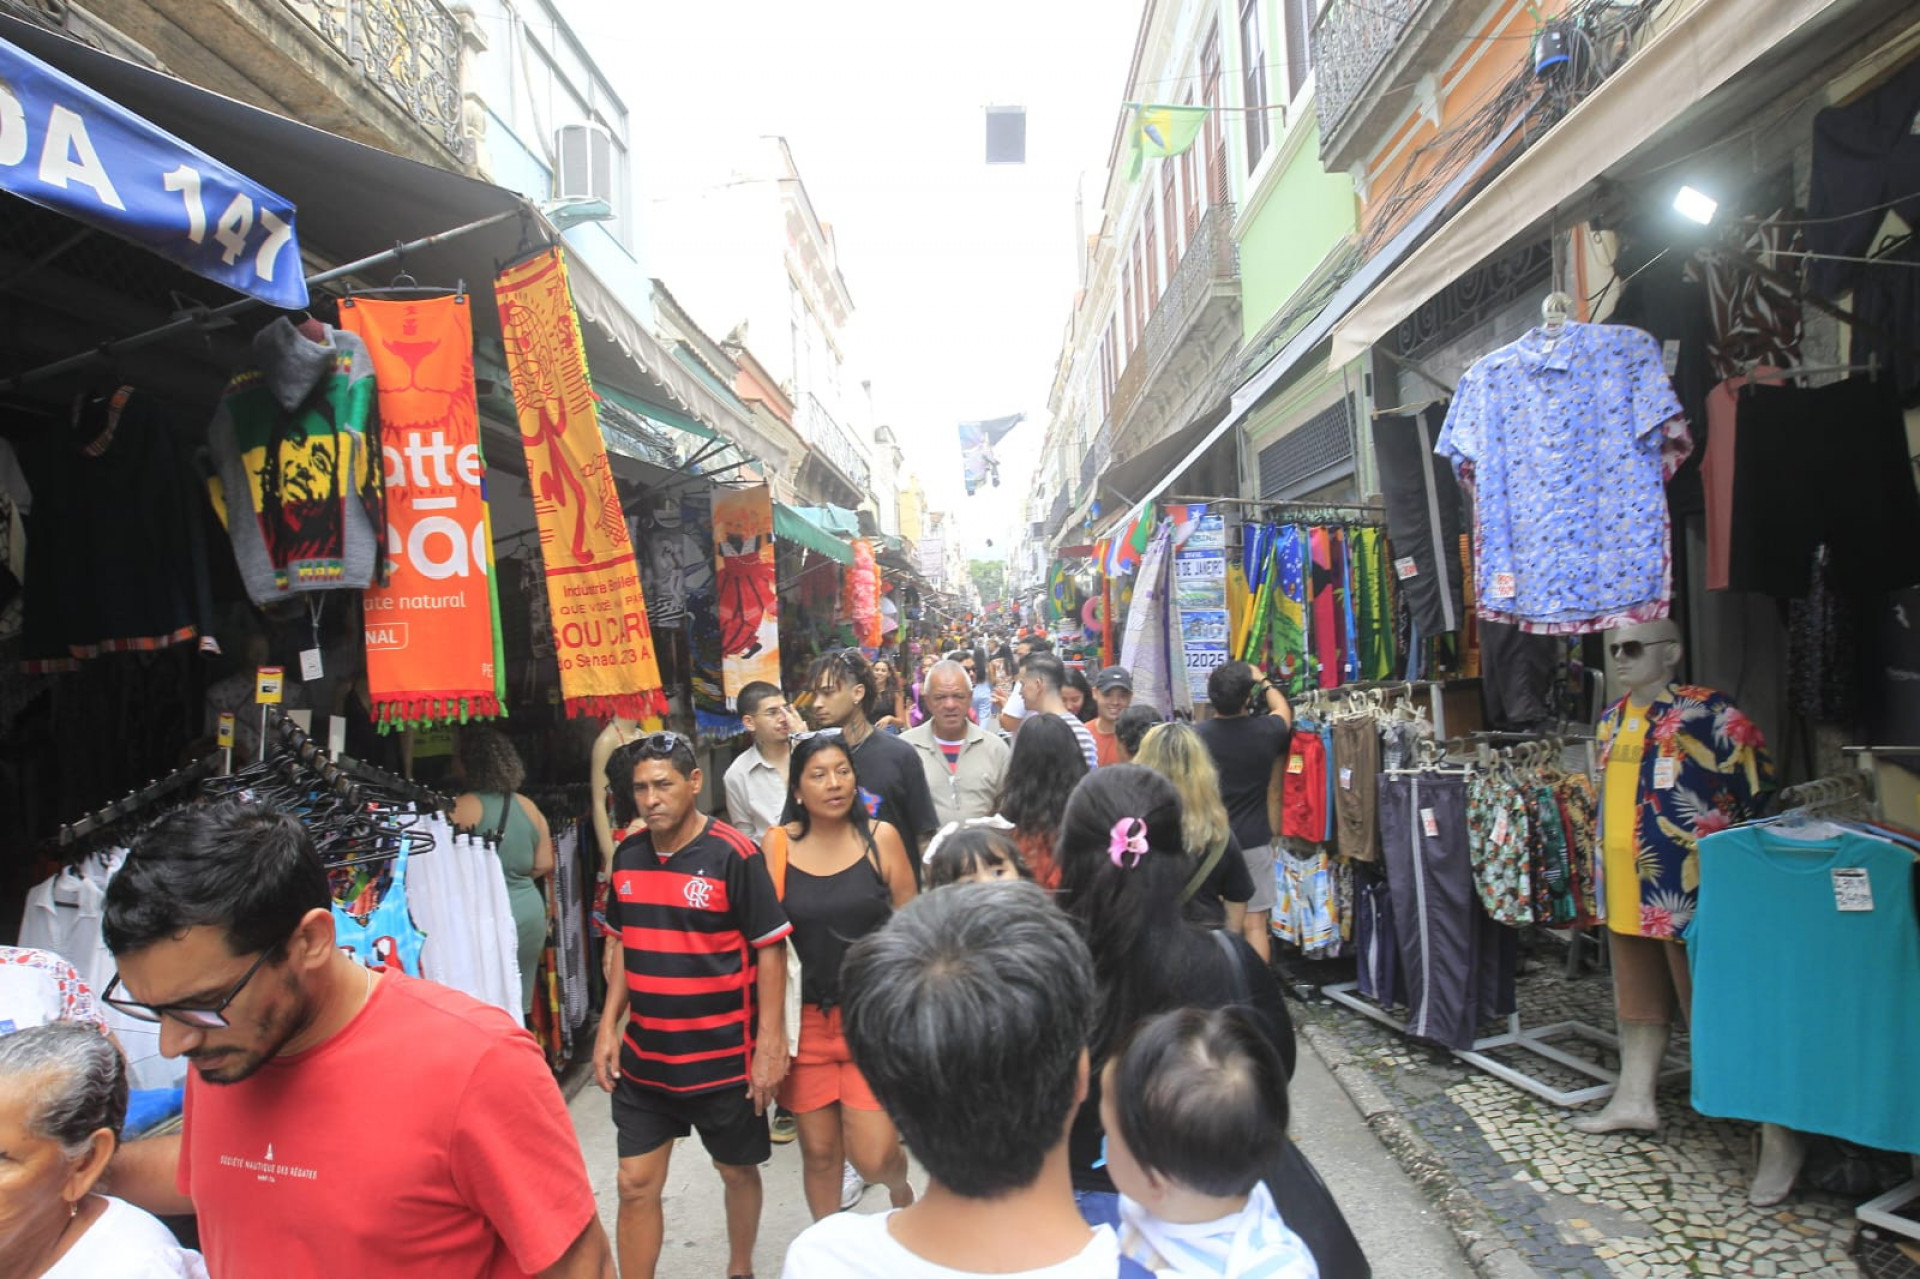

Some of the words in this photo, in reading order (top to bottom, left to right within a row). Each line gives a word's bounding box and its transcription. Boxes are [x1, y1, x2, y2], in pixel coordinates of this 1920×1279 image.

[163, 164, 292, 282] 147
[399, 590, 467, 610] natural
[365, 628, 398, 646] NAL
